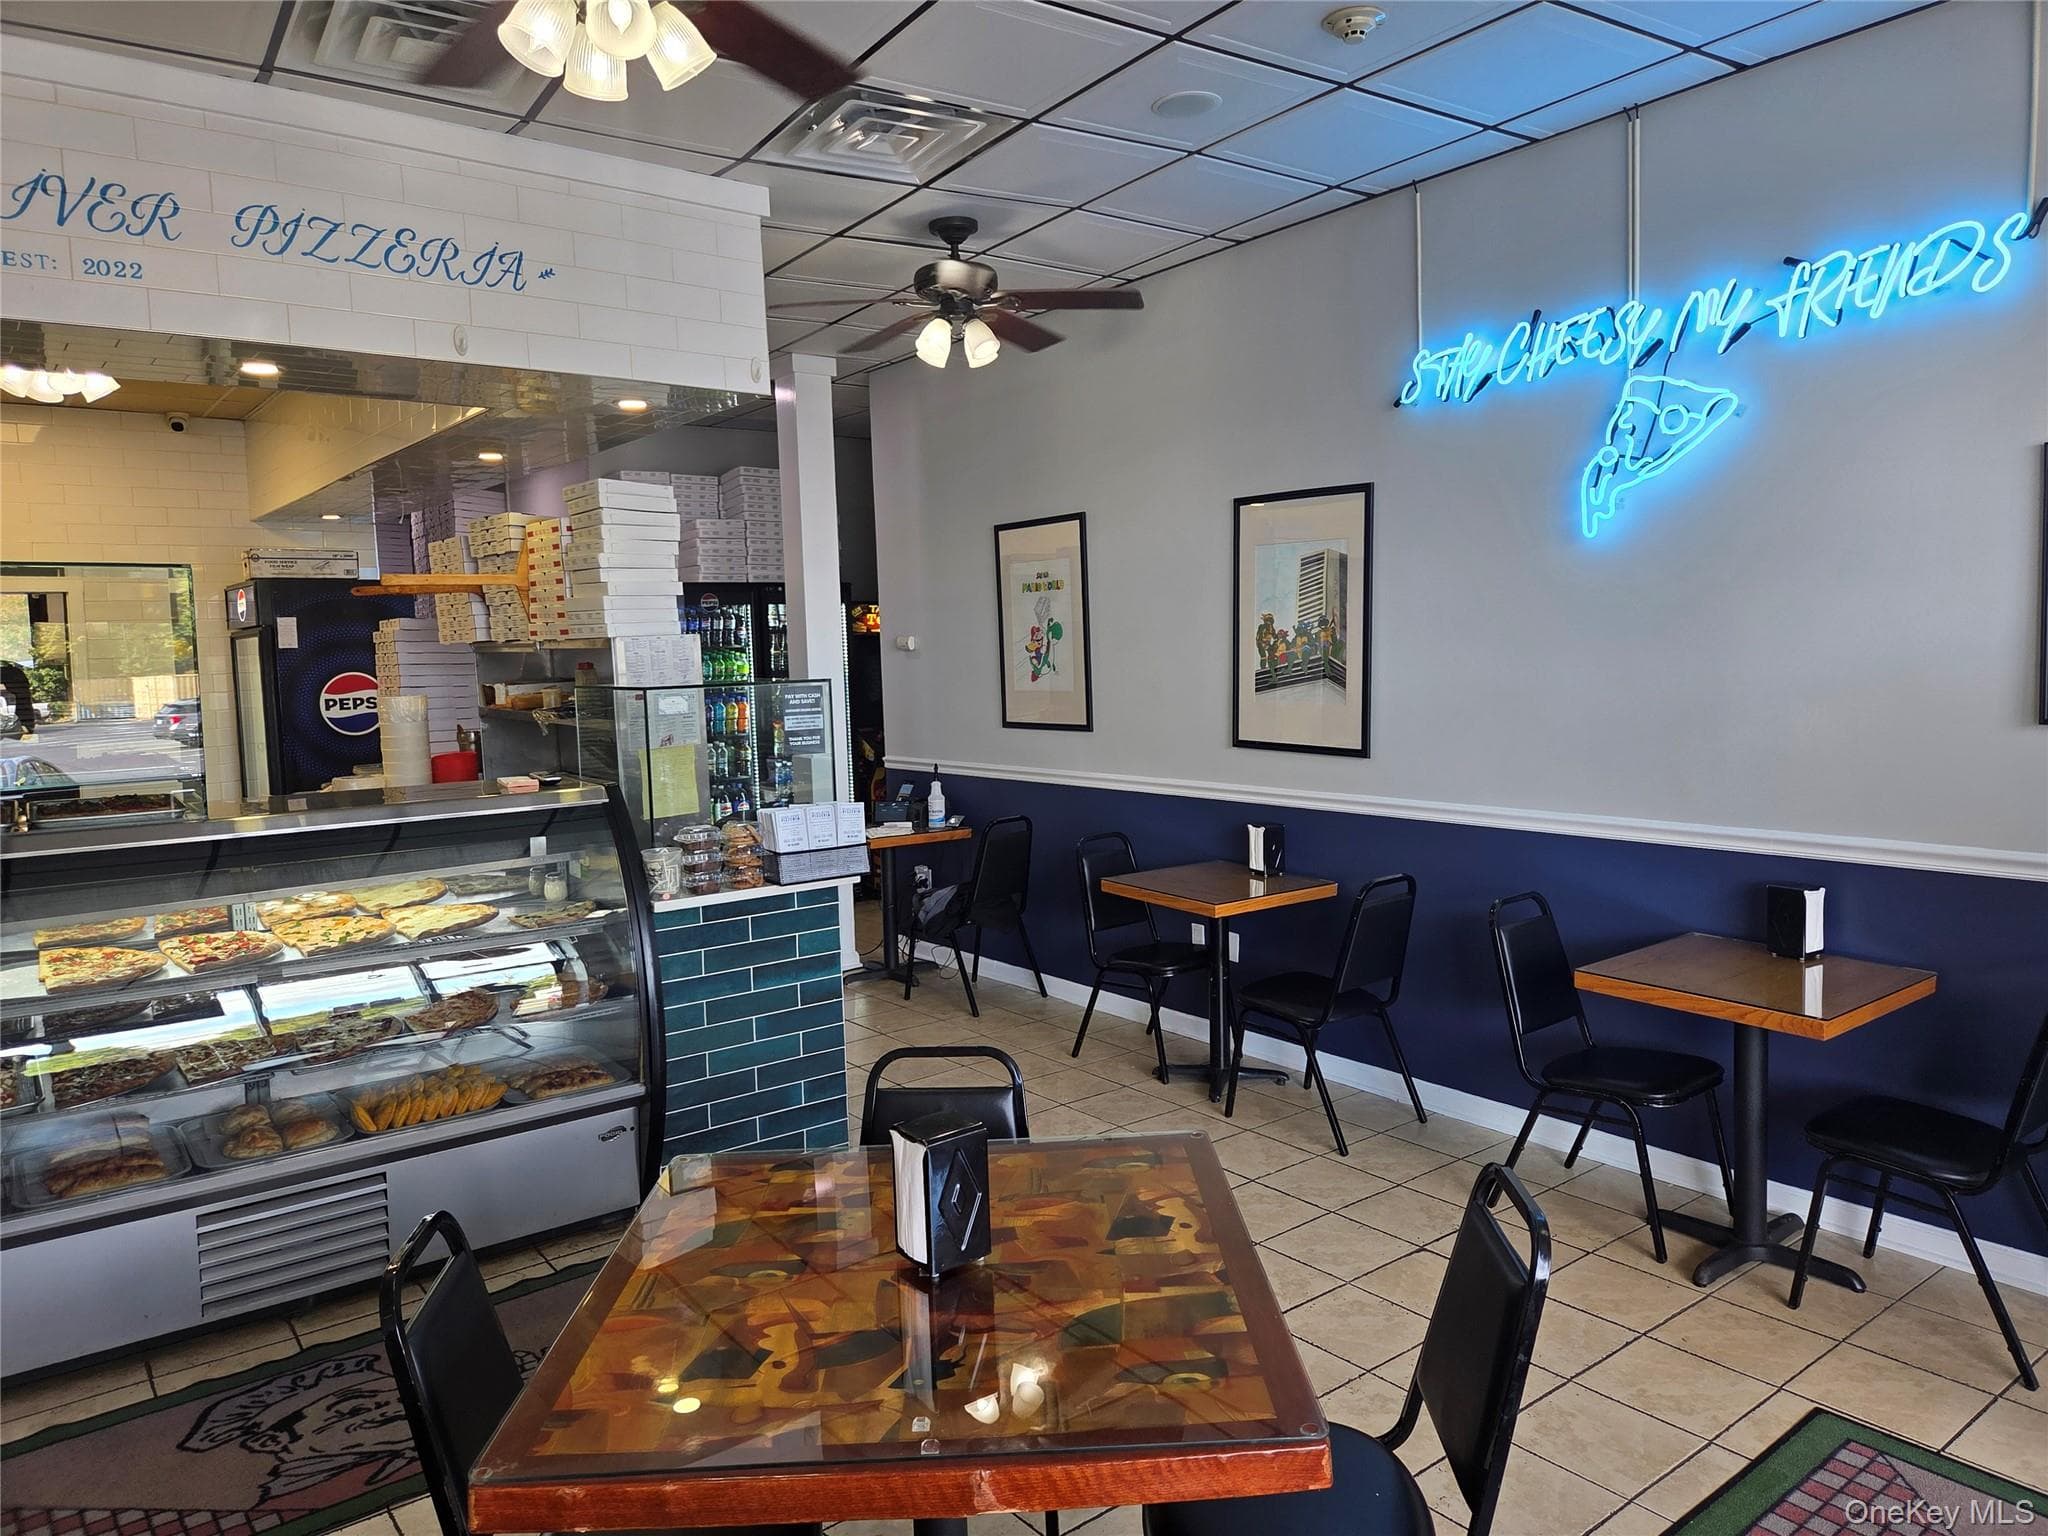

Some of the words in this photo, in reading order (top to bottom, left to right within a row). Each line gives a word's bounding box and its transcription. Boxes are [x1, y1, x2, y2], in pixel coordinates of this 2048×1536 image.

[1, 251, 57, 270] EST:
[82, 258, 143, 279] 2022
[231, 204, 527, 291] PIZZERIA
[1401, 332, 1492, 404] STAY
[1498, 300, 1662, 384] CHEESY
[1670, 278, 1753, 354] MY
[1766, 212, 2028, 338] FRIENDS
[324, 696, 377, 711] PEPS
